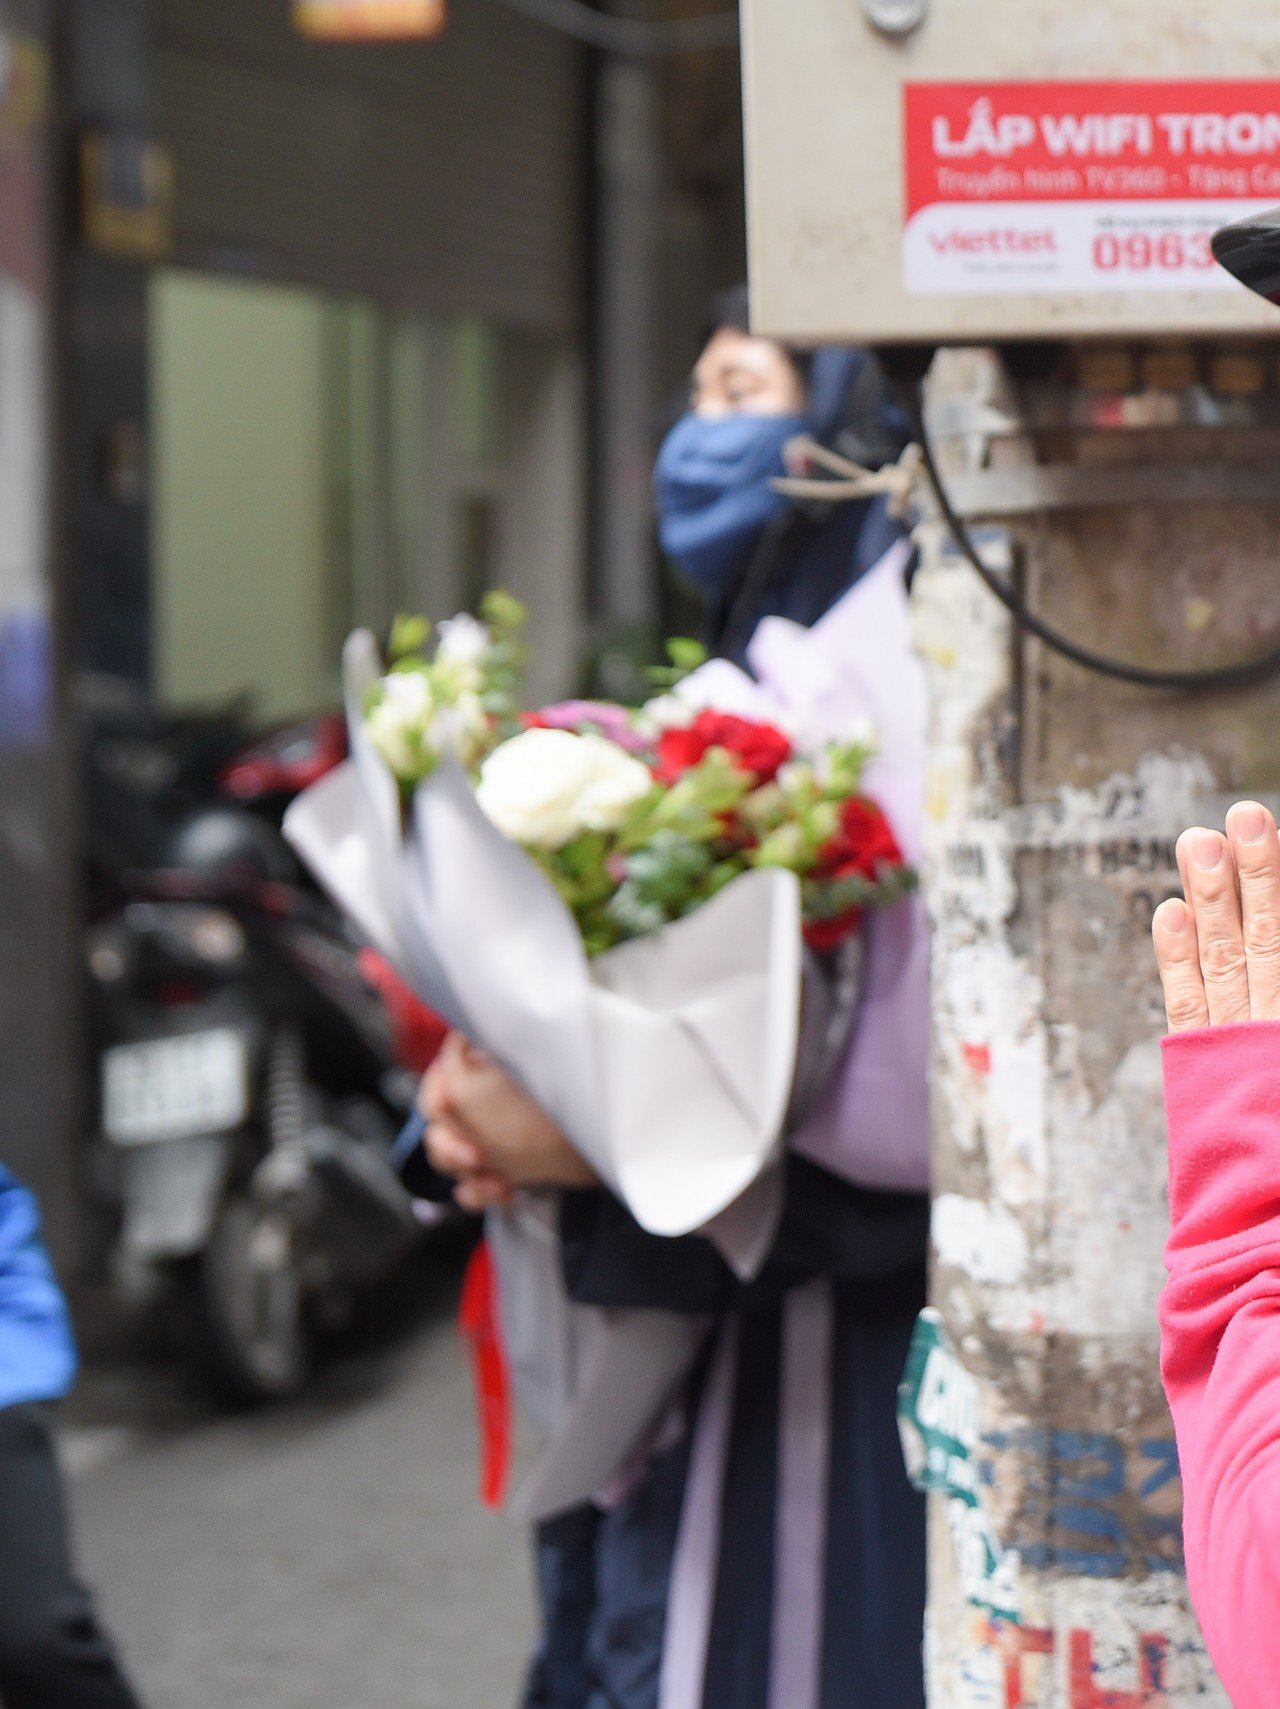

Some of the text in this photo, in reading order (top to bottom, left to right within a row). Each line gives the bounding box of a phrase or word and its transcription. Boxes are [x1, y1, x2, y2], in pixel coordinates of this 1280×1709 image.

[1040, 113, 1151, 157] WIFI
[1086, 165, 1168, 193] TV360
[928, 227, 1058, 254] viettel
